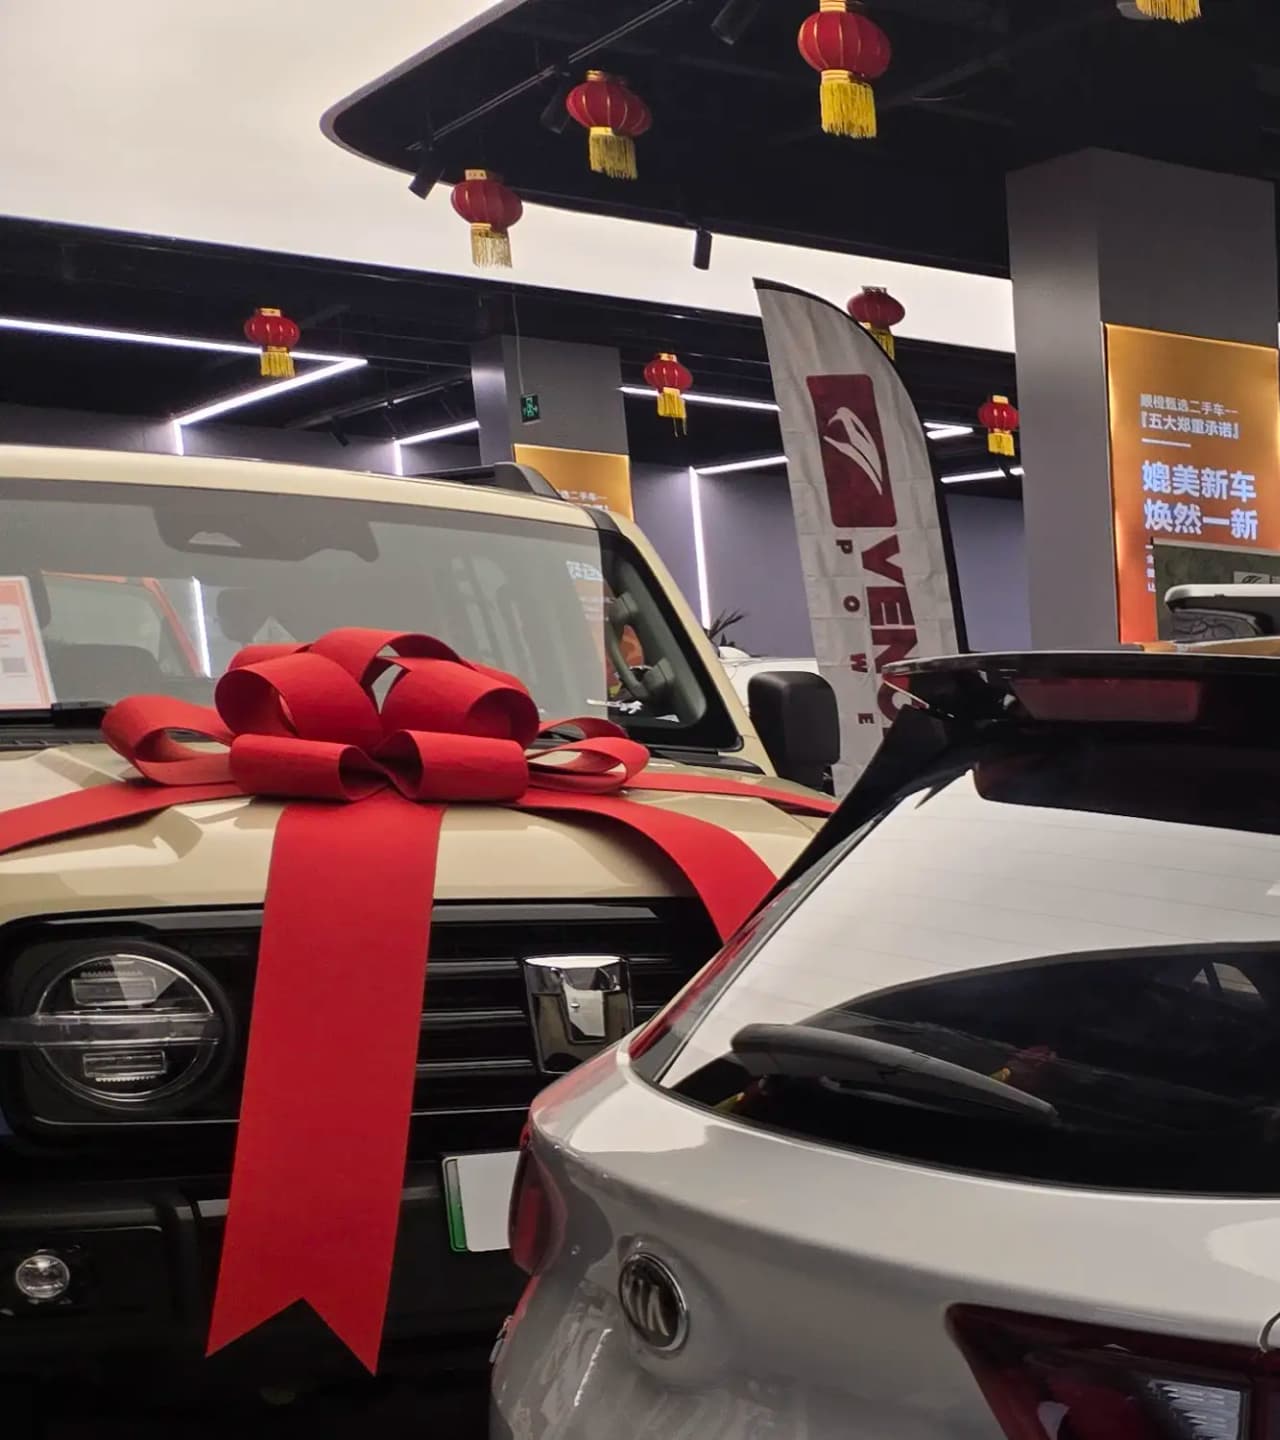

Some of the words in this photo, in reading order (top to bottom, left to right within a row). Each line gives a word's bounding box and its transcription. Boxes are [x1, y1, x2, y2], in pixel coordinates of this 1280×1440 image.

[1142, 460, 1257, 502] 媲美新车
[1144, 498, 1258, 540] 焕然一新
[861, 533, 921, 737] VENO
